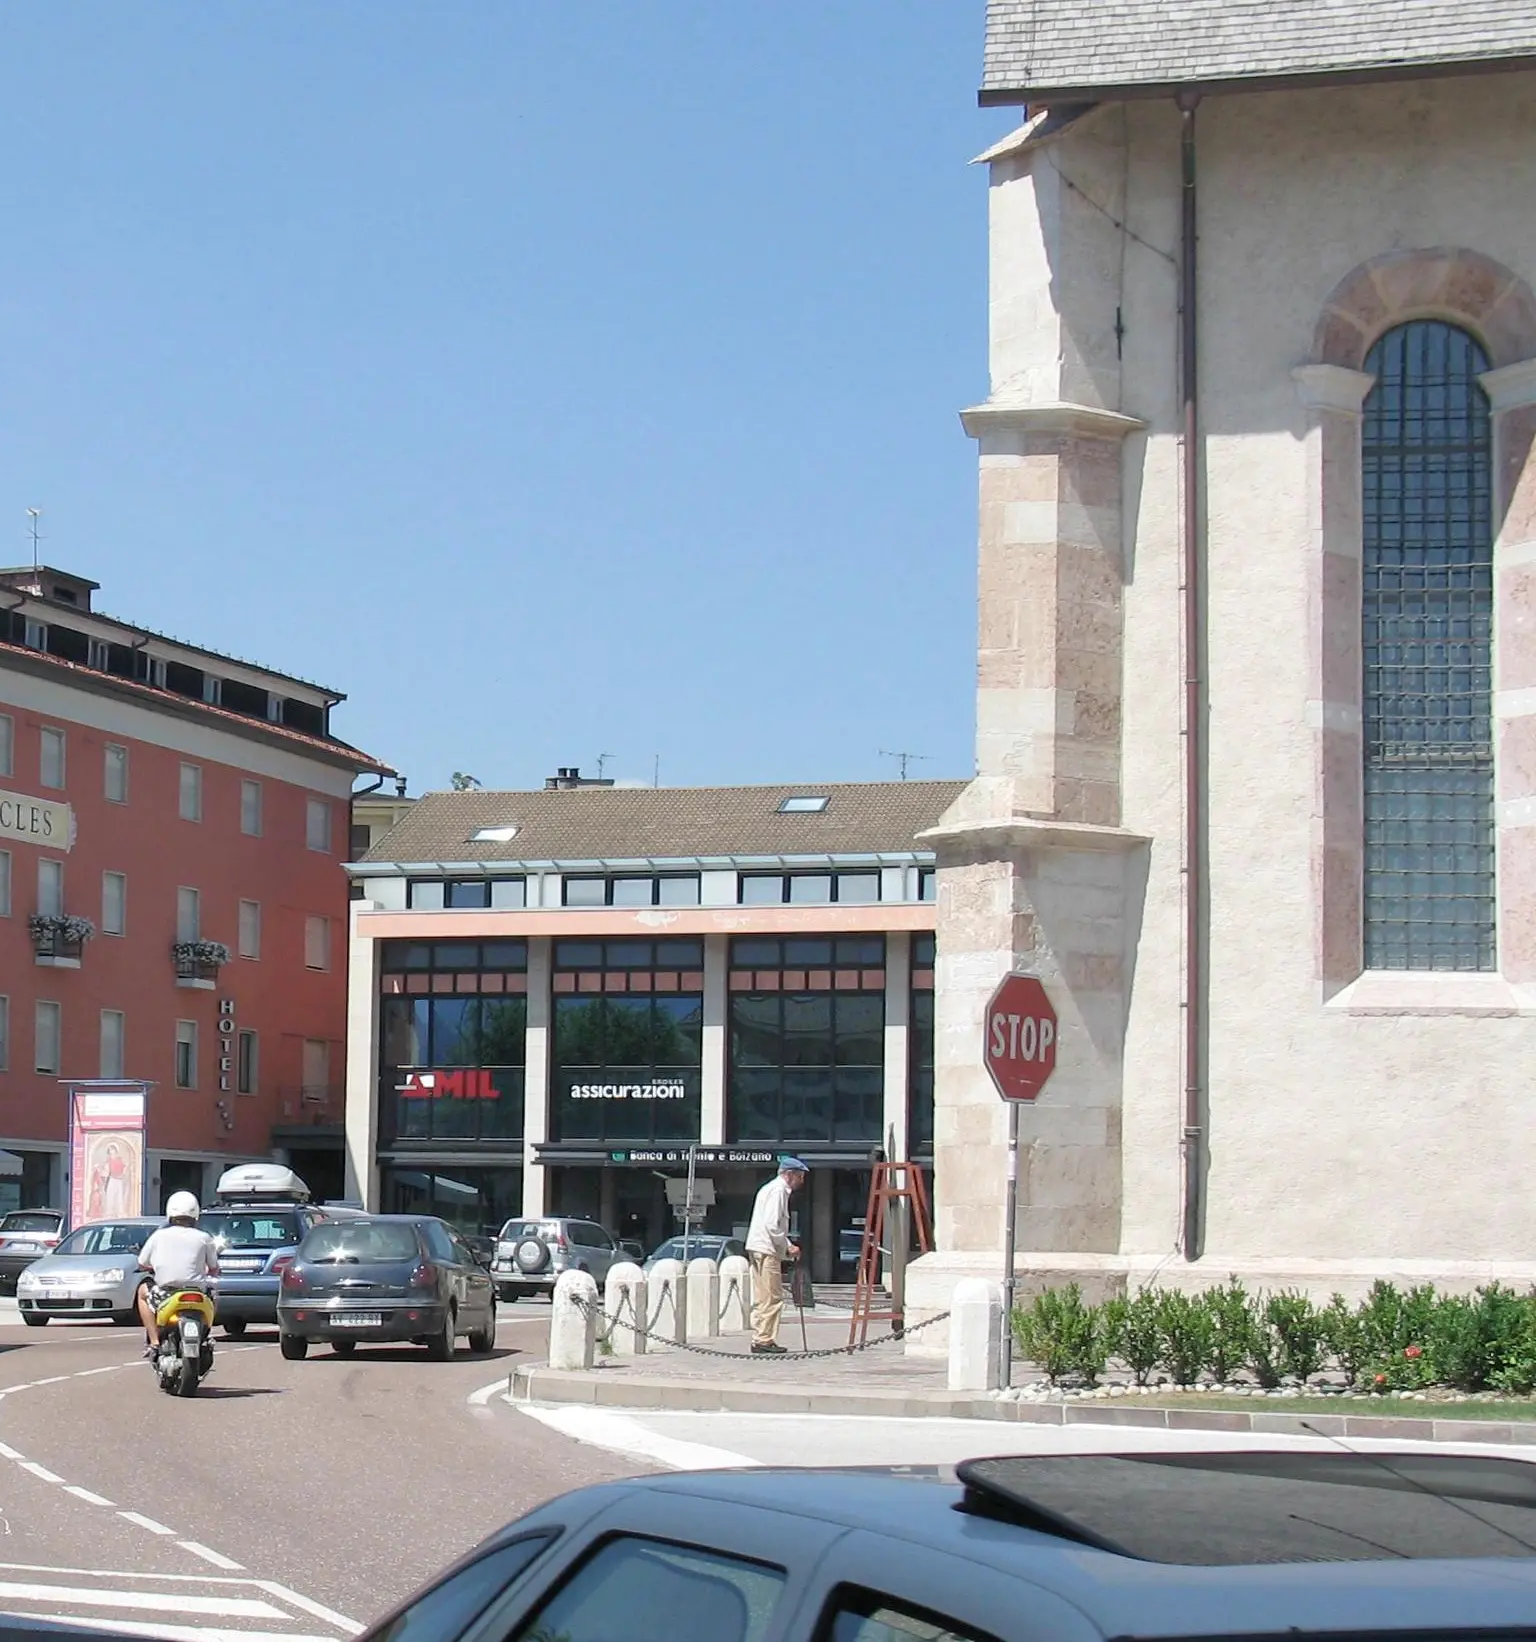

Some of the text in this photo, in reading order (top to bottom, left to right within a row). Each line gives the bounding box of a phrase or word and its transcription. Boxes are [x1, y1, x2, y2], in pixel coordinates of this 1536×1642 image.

[0, 800, 53, 836] CLES
[219, 1000, 235, 1091] HOTEL
[991, 1012, 1054, 1063] STOP
[570, 1085, 684, 1099] assicurazioni
[630, 1150, 663, 1161] Banca
[666, 1150, 677, 1161] di
[718, 1152, 726, 1161] e
